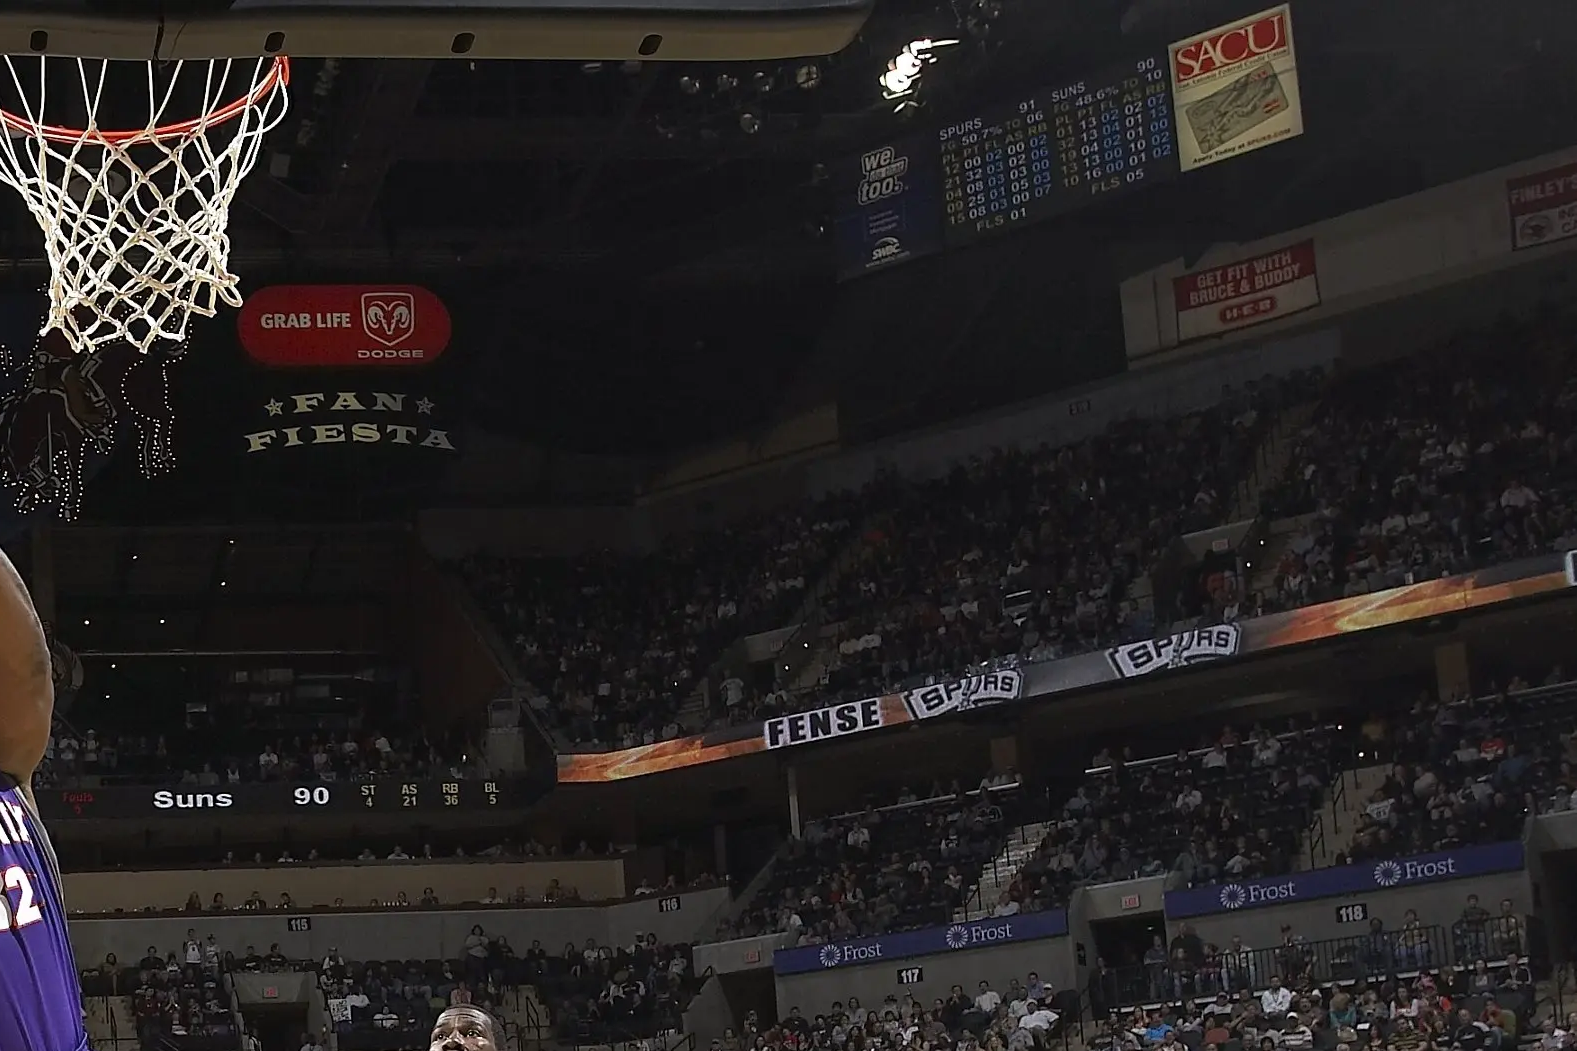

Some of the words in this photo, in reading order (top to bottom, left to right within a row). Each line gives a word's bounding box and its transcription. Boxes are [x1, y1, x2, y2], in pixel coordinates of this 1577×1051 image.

[1176, 15, 1282, 80] SACU
[1137, 57, 1155, 72] 90
[1051, 81, 1086, 102] SUNS
[1075, 85, 1119, 107] 48.6%
[1146, 69, 1162, 81] 10
[1018, 99, 1035, 113] 91
[1026, 110, 1044, 124] 06
[1079, 116, 1097, 129] 13
[1125, 101, 1142, 115] 02
[1147, 93, 1165, 107] 07
[939, 117, 983, 140] SPURS
[1080, 129, 1098, 142] 13
[1125, 114, 1143, 128] 01
[1081, 141, 1099, 156] 04
[1126, 126, 1143, 140] 01
[1150, 118, 1168, 132] 00
[964, 155, 981, 169] 00
[1007, 141, 1025, 155] 00
[1029, 134, 1047, 148] 02
[1083, 154, 1100, 167] 13
[1129, 139, 1146, 152] 10
[1151, 131, 1169, 145] 02
[864, 149, 892, 172] we
[965, 167, 982, 181] 32
[1008, 153, 1026, 167] 02
[1030, 146, 1048, 160] 06
[1084, 167, 1102, 180] 16
[1128, 151, 1146, 166] 01
[1152, 144, 1171, 158] 02
[966, 180, 984, 194] 08
[1009, 166, 1027, 180] 03
[1032, 159, 1049, 172] 00
[1126, 168, 1144, 182] 05
[968, 193, 985, 207] 25
[1011, 178, 1029, 192] 05
[1033, 171, 1051, 185] 03
[968, 205, 987, 219] 08
[1012, 191, 1030, 205] 00
[1034, 184, 1052, 198] 07
[1010, 207, 1027, 220] 01
[1196, 270, 1223, 289] GET
[1227, 263, 1250, 281] FIT
[1252, 249, 1293, 274] WITH
[1189, 281, 1236, 306] BRUCE
[1239, 278, 1252, 294] &
[1254, 262, 1301, 290] BUDDY
[260, 312, 312, 329] GRAB
[316, 312, 352, 329] LIFE
[357, 349, 424, 359] DODGE
[290, 391, 407, 414] FAN
[243, 422, 457, 453] FIESTA
[1131, 628, 1230, 670] SPURS
[920, 669, 1016, 711] SPURS
[767, 699, 881, 747] FENSE
[153, 790, 233, 808] Suns
[293, 787, 330, 805] 90
[360, 784, 377, 796] ST
[401, 783, 418, 795] AS
[442, 783, 459, 794] RB
[484, 782, 500, 793] BL
[489, 793, 496, 804] 5
[365, 797, 373, 808] 4
[403, 796, 417, 807] 21
[444, 795, 459, 806] 36
[1405, 857, 1456, 880] Frost
[1248, 881, 1296, 903] Frost
[291, 917, 310, 931] 115
[1339, 905, 1364, 922] 118
[971, 922, 1012, 943] Frost
[842, 941, 882, 962] Frost
[900, 969, 920, 984] 117
